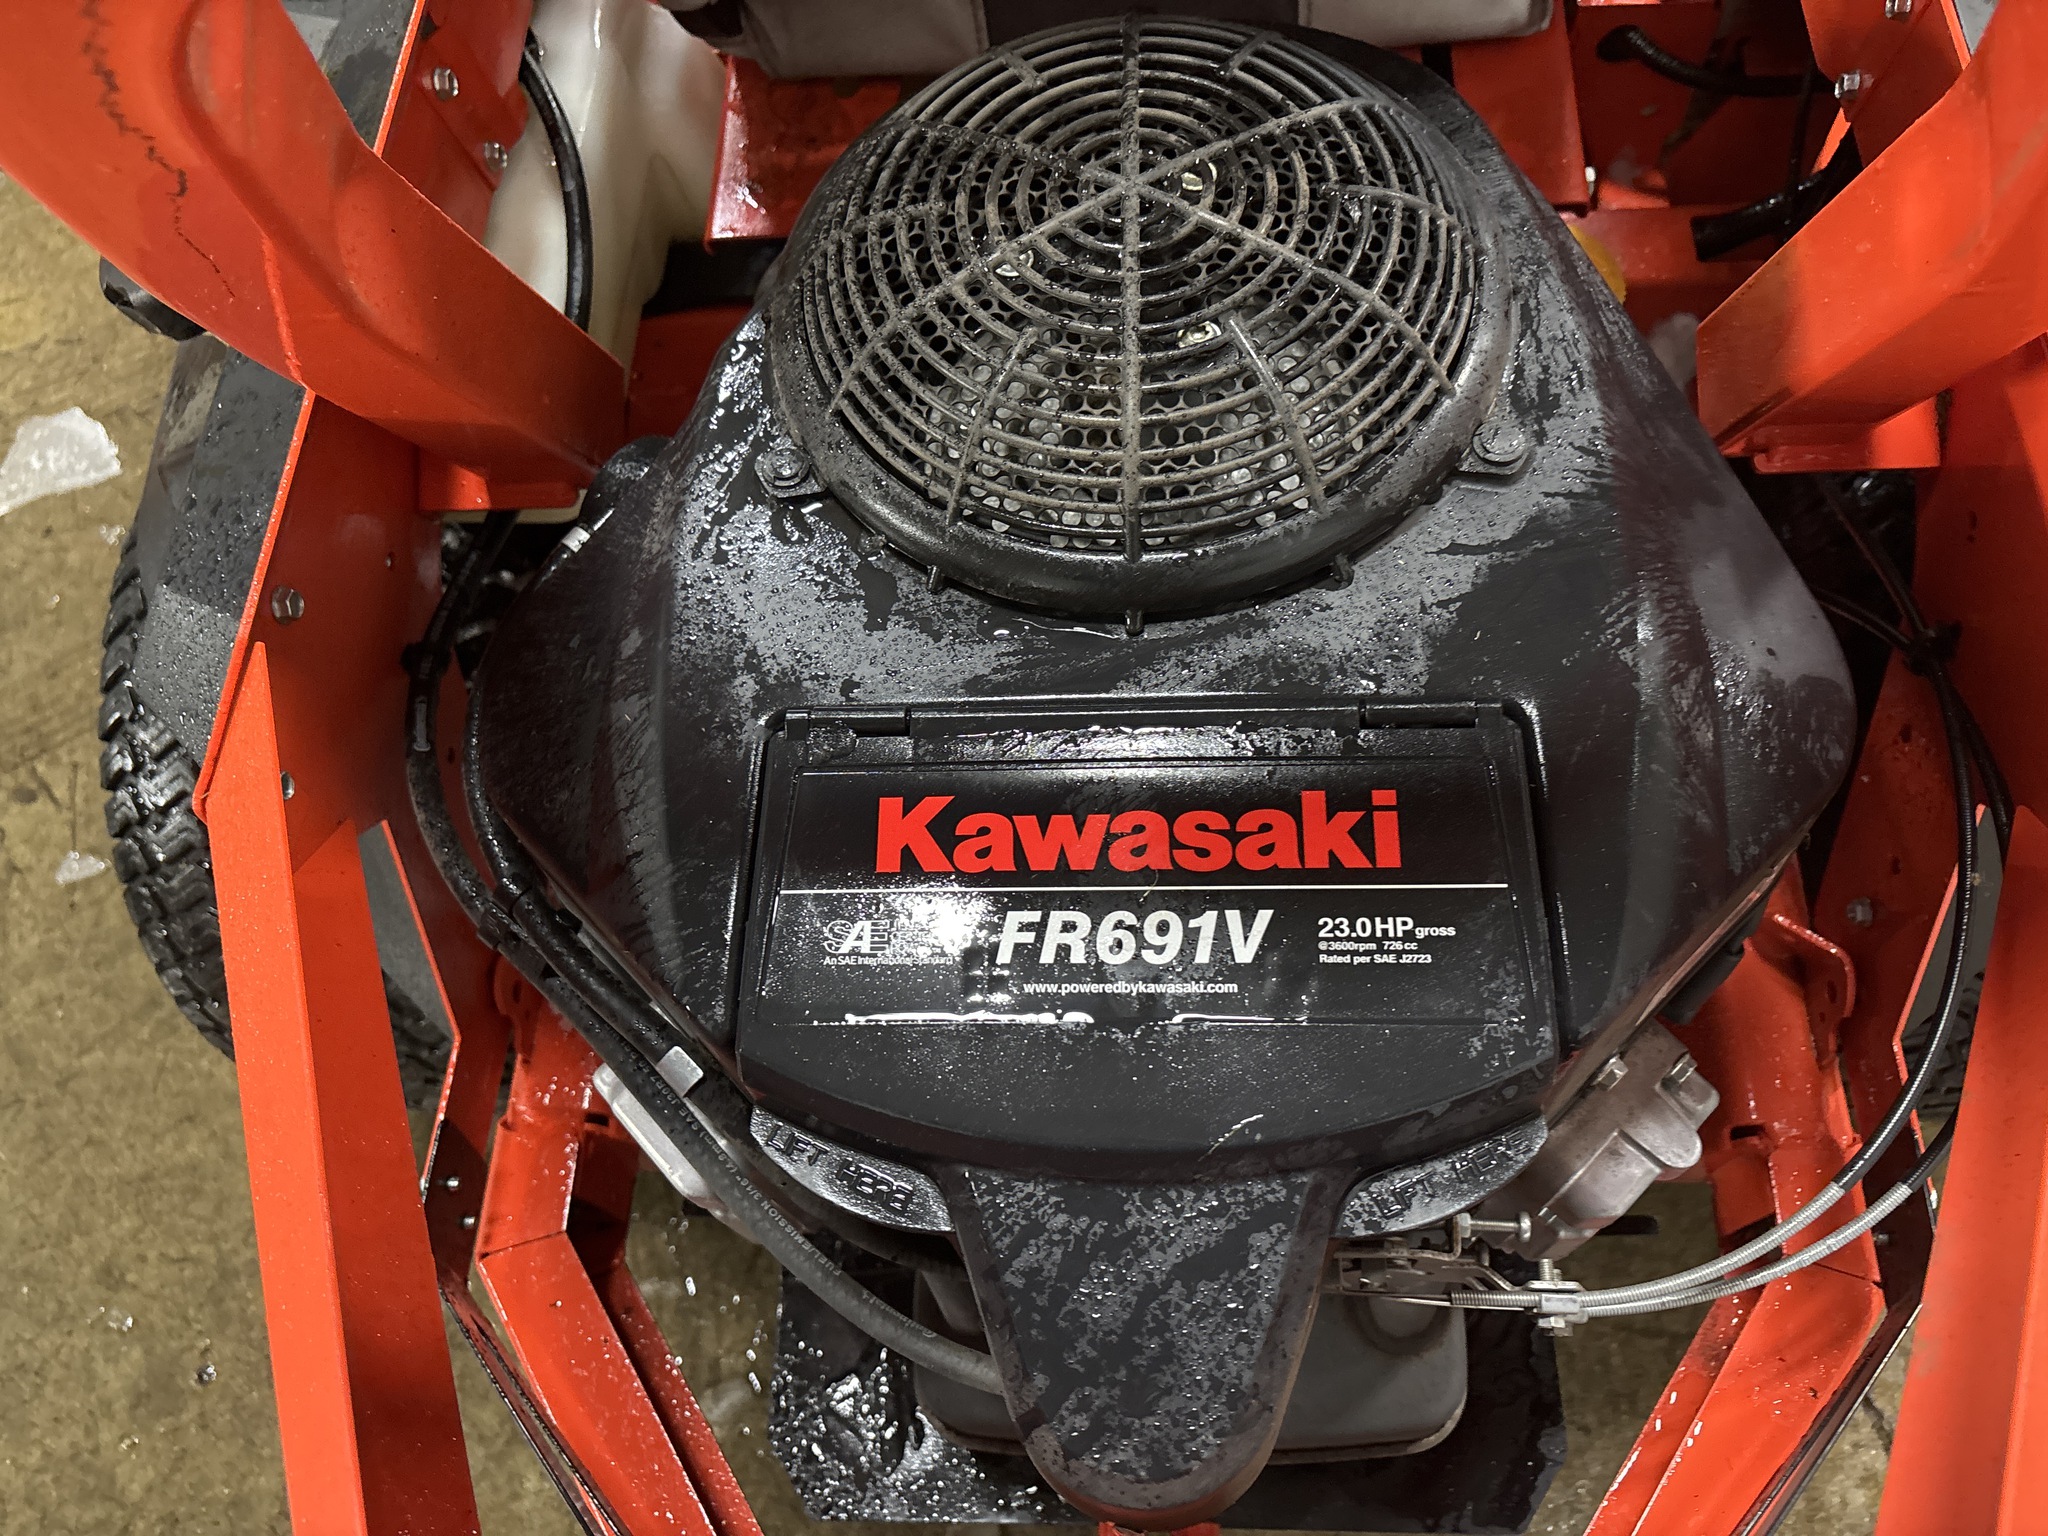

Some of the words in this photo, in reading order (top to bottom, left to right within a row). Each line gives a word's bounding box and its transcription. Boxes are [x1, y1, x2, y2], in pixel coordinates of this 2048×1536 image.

[875, 789, 1402, 874] Kawasaki
[995, 909, 1275, 965] FR691V
[823, 955, 837, 965] An
[838, 955, 857, 965] SAE
[1319, 954, 1351, 964] Rated
[1353, 955, 1371, 966] per
[1374, 954, 1398, 964] SAE
[1399, 954, 1433, 964] J2723
[1023, 980, 1238, 996] www.poweredbykawasaki.com
[649, 1074, 681, 1105] J30R7
[678, 1107, 699, 1131] SAE
[767, 1123, 830, 1167] LIFT
[835, 1158, 914, 1216] HERE
[1373, 1166, 1434, 1220] LIFT
[1451, 1130, 1535, 1184] HERE
[759, 1200, 842, 1277] FUEL/EMISSION
